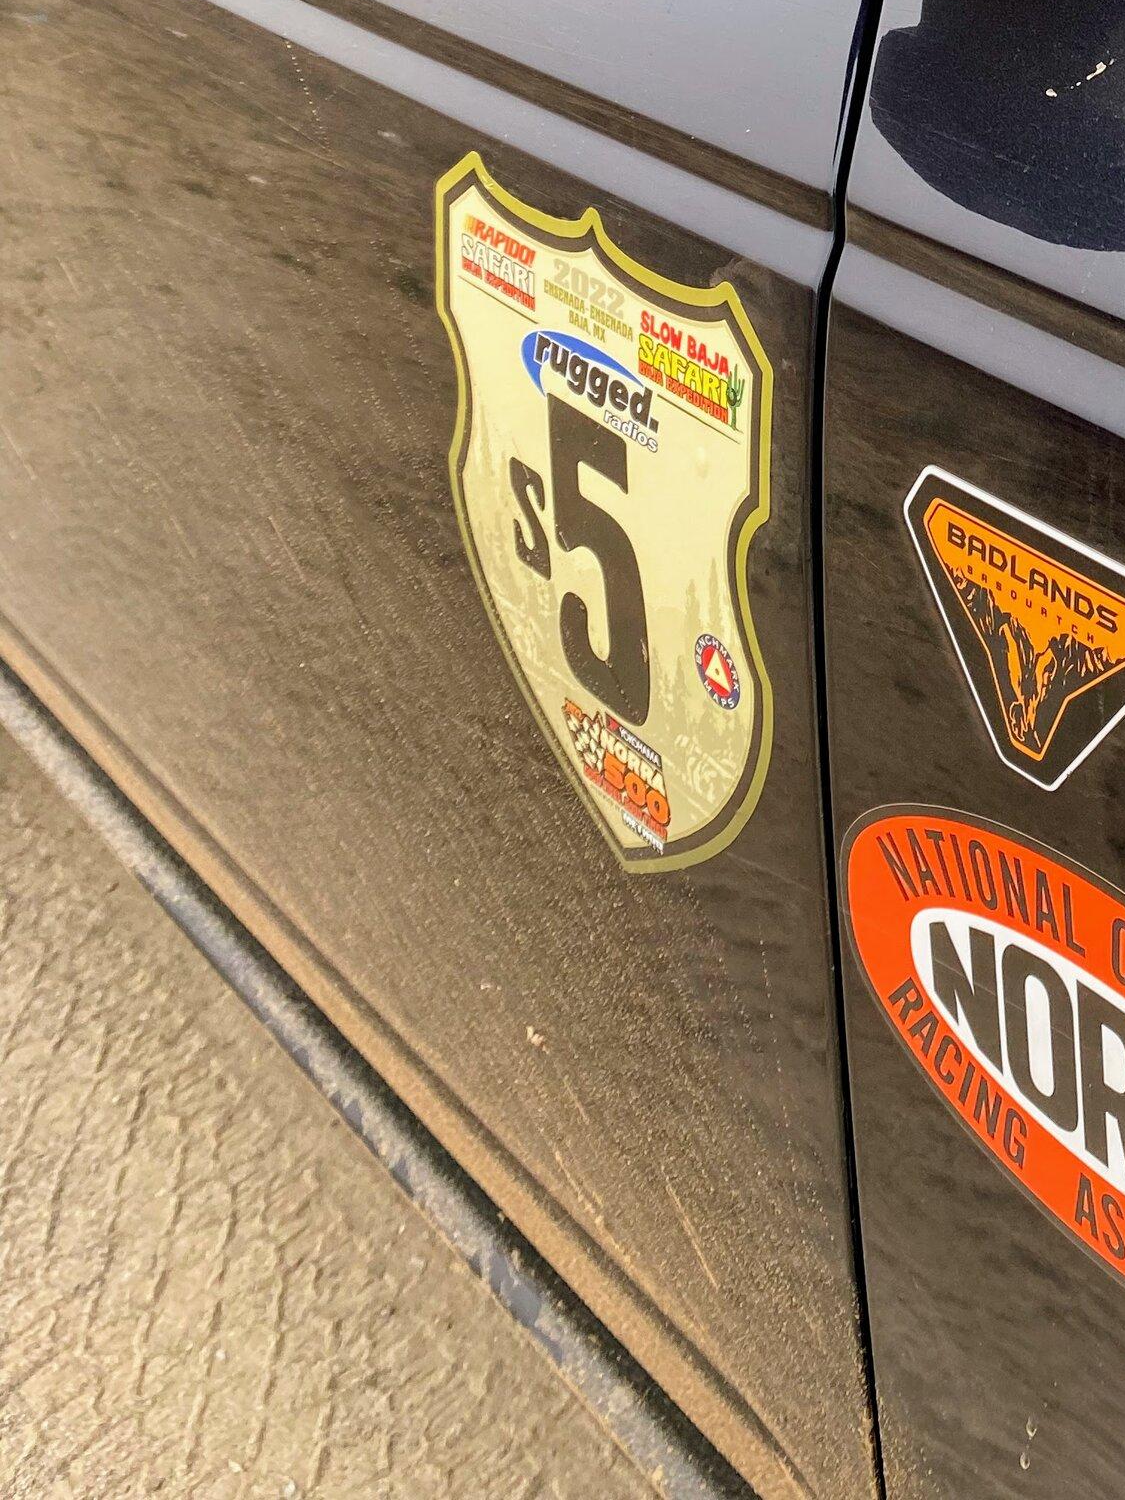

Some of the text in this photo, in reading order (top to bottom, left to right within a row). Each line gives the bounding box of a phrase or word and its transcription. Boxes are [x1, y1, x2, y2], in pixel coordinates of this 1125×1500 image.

[461, 233, 536, 296] SAFARI
[473, 217, 537, 268] RAPIDO!
[543, 278, 586, 313] ENSENADA
[589, 304, 634, 343] ENSENADA
[554, 258, 626, 320] 2022
[592, 325, 606, 344] MX
[640, 309, 729, 378] SLOW BAJA
[638, 332, 729, 410] SAFARI
[638, 360, 729, 426] BAJA EXPEDITION
[602, 408, 659, 454] radios
[947, 521, 1119, 634] BADLANDS
[966, 564, 1095, 644] SASQUATCH
[695, 634, 740, 693] BENCHMARK
[703, 680, 735, 709] MAPS
[600, 728, 667, 799] NORRA
[603, 750, 672, 826] 500
[876, 827, 1086, 959] NATIONAL
[887, 976, 1029, 1170] RACING
